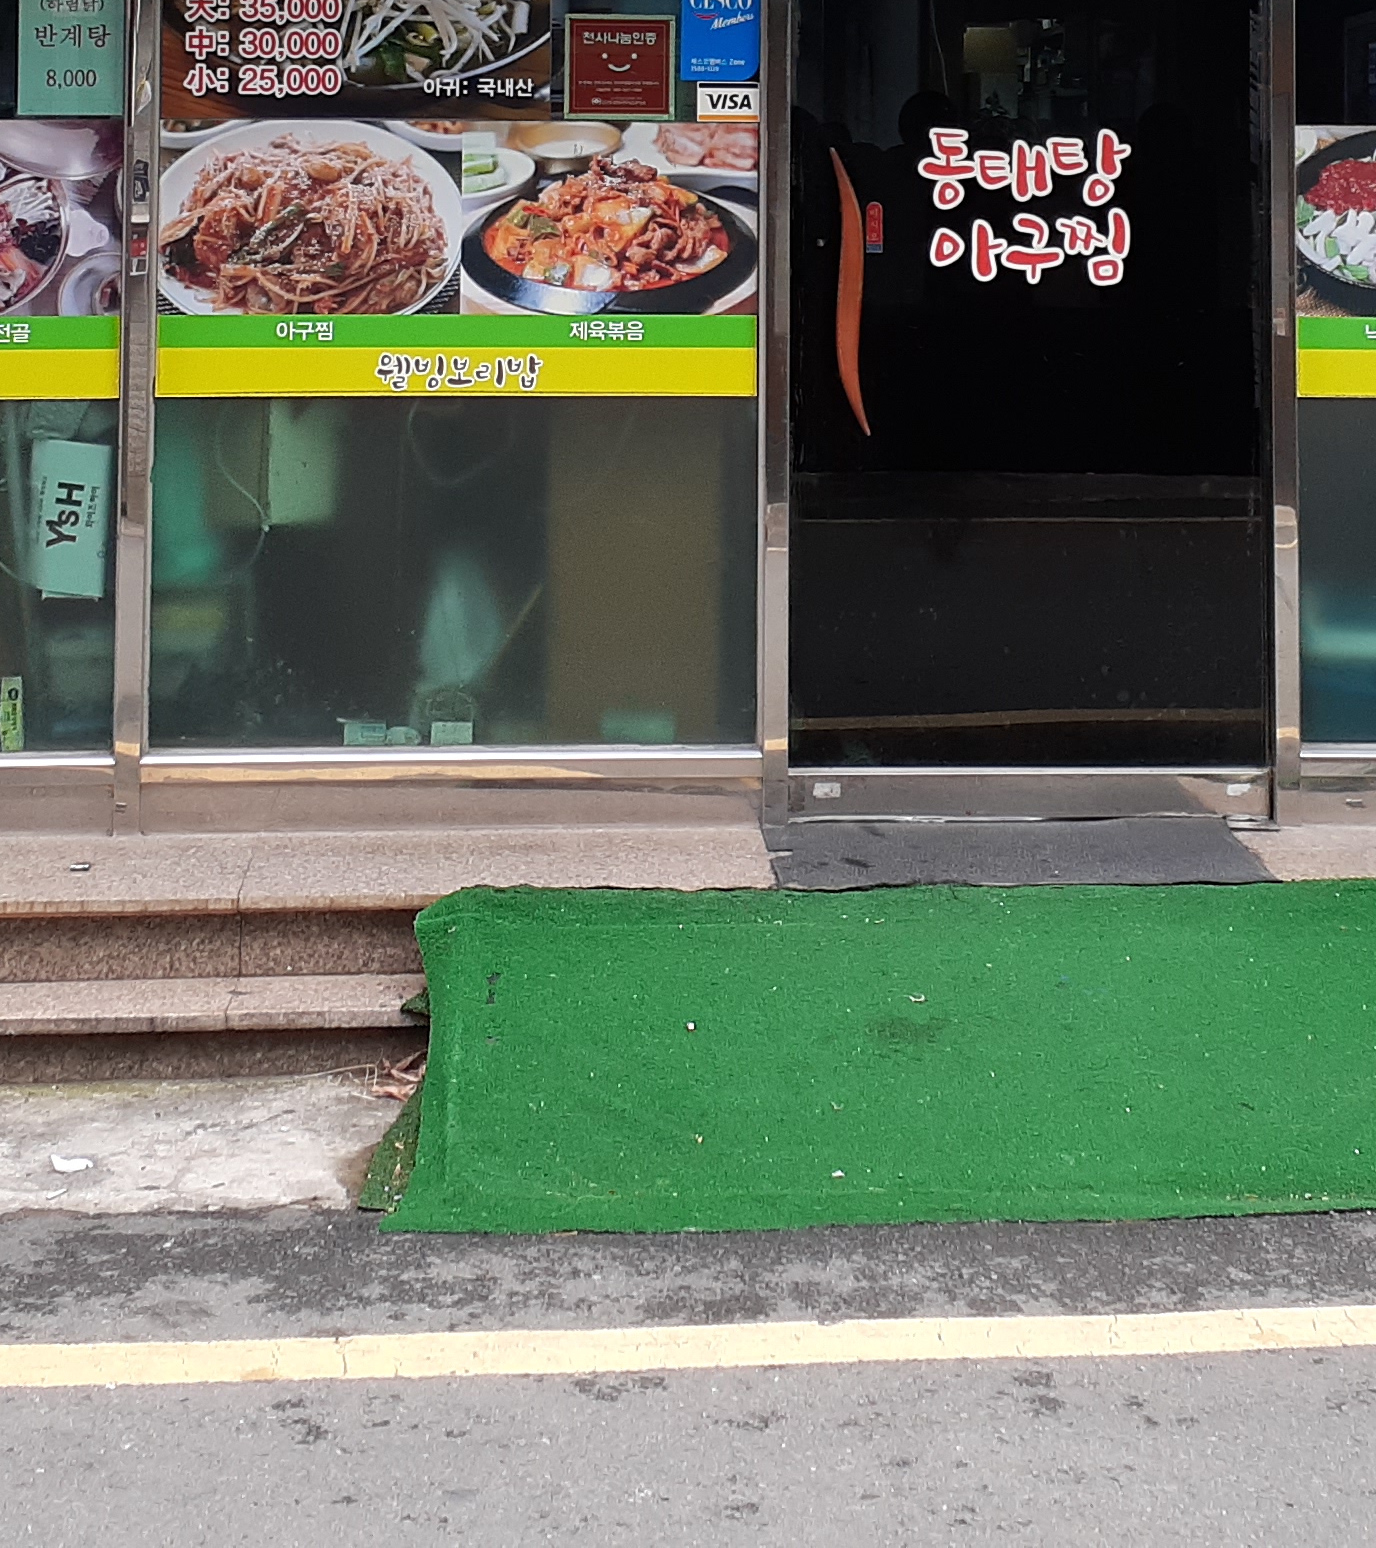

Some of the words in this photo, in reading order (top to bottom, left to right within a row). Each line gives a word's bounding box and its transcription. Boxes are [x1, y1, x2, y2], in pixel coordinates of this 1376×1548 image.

[34, 23, 112, 49] 반계탕
[238, 27, 344, 62] 30,000
[45, 69, 98, 90] 8,000
[238, 64, 344, 99] 25,000
[423, 78, 469, 97] 아귀:
[476, 77, 535, 98] 국내산
[705, 93, 753, 110] VISA
[918, 127, 1132, 210] 동태탕
[929, 207, 1132, 287] 아구찜
[274, 320, 336, 342] 아구찜
[568, 320, 646, 343] 제육볶음
[374, 352, 545, 392] 웰빙보리밥
